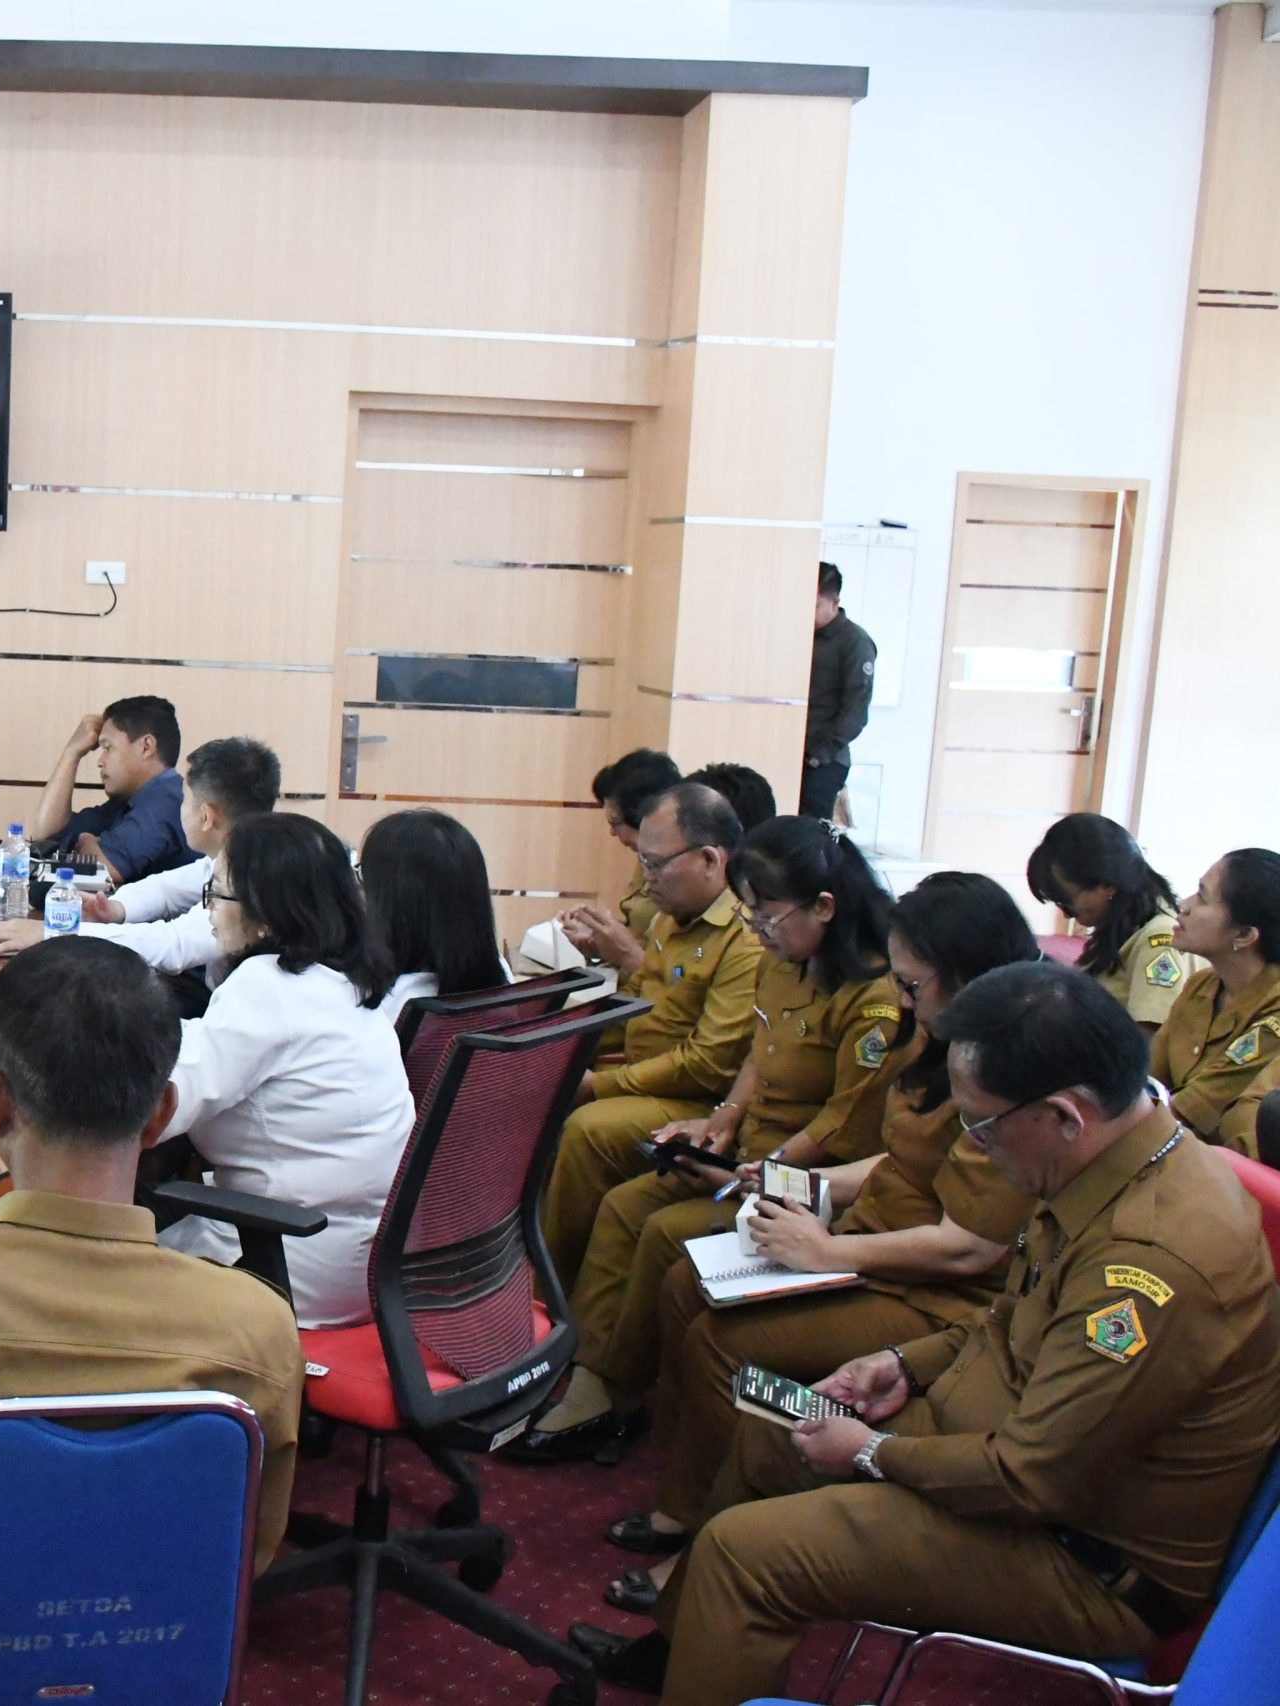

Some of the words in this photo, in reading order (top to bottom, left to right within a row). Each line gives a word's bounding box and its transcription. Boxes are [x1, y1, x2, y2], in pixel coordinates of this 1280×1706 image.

[1114, 1276, 1160, 1298] SAMOSIR
[508, 1371, 531, 1393] APBD
[531, 1361, 550, 1379] 2018
[37, 1596, 131, 1617] SETDA
[63, 1630, 107, 1648] T.A
[117, 1624, 184, 1644] 2017
